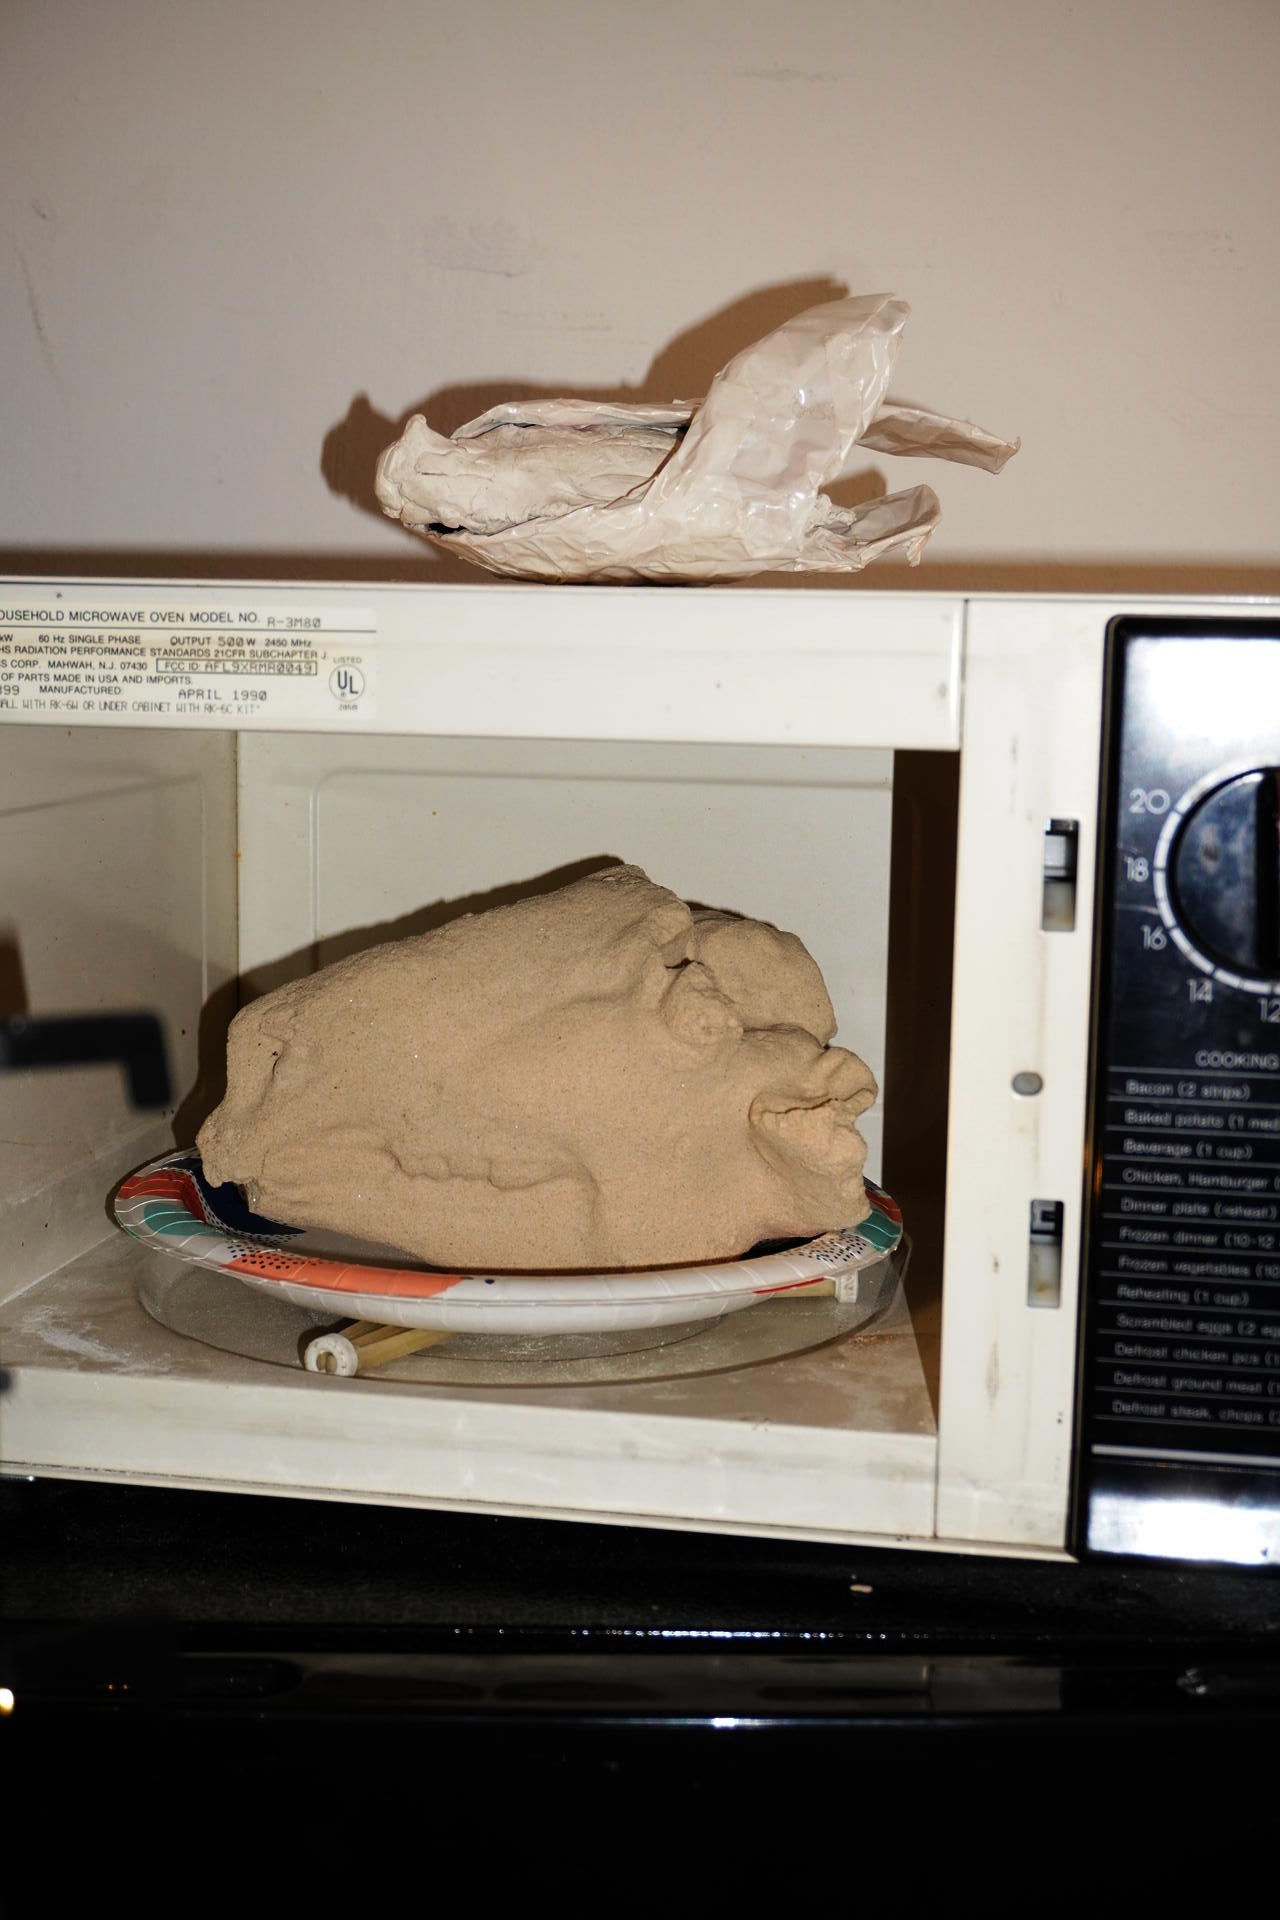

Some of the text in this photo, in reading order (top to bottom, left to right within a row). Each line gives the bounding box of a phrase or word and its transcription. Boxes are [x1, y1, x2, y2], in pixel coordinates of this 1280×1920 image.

[69, 611, 145, 622] MICROWAVE
[150, 612, 184, 623] OVEN
[190, 612, 234, 624] MODEL
[267, 617, 321, 628] R-3M80
[38, 634, 49, 643] 60
[53, 635, 64, 643] Hz
[68, 635, 104, 644] SINGLE
[108, 636, 141, 645] PHASE
[170, 636, 211, 646] OUTPUT
[265, 638, 287, 647] 2450
[290, 639, 312, 648] MHz
[14, 645, 66, 655] RADIATION
[70, 646, 146, 656] PERFORMANCE
[150, 648, 210, 658] STANDARDS
[214, 650, 245, 658] 21CFR
[250, 650, 318, 660] SUBCHAPTER
[333, 656, 362, 664] LISTED
[120, 662, 148, 671] 07430
[165, 662, 184, 672] FCC
[1, 673, 14, 681] OF
[18, 673, 50, 682] PARTS
[54, 674, 81, 683] MADE
[85, 675, 94, 683] IN
[99, 675, 118, 684] USA
[122, 676, 142, 684] AND
[0, 685, 20, 696] 99
[178, 689, 222, 700] APRIL
[233, 690, 267, 702] 1990
[22, 699, 46, 710] WITH
[83, 700, 94, 710] OR
[99, 701, 128, 712] UNDER
[132, 702, 170, 712] CABINET
[176, 703, 200, 713] WITH
[1128, 788, 1170, 815] 20
[1126, 857, 1149, 882] 18
[1141, 925, 1167, 950] 16
[1187, 978, 1213, 1003] 14
[1258, 997, 1280, 1023] 12
[1195, 1050, 1280, 1070] COOKING
